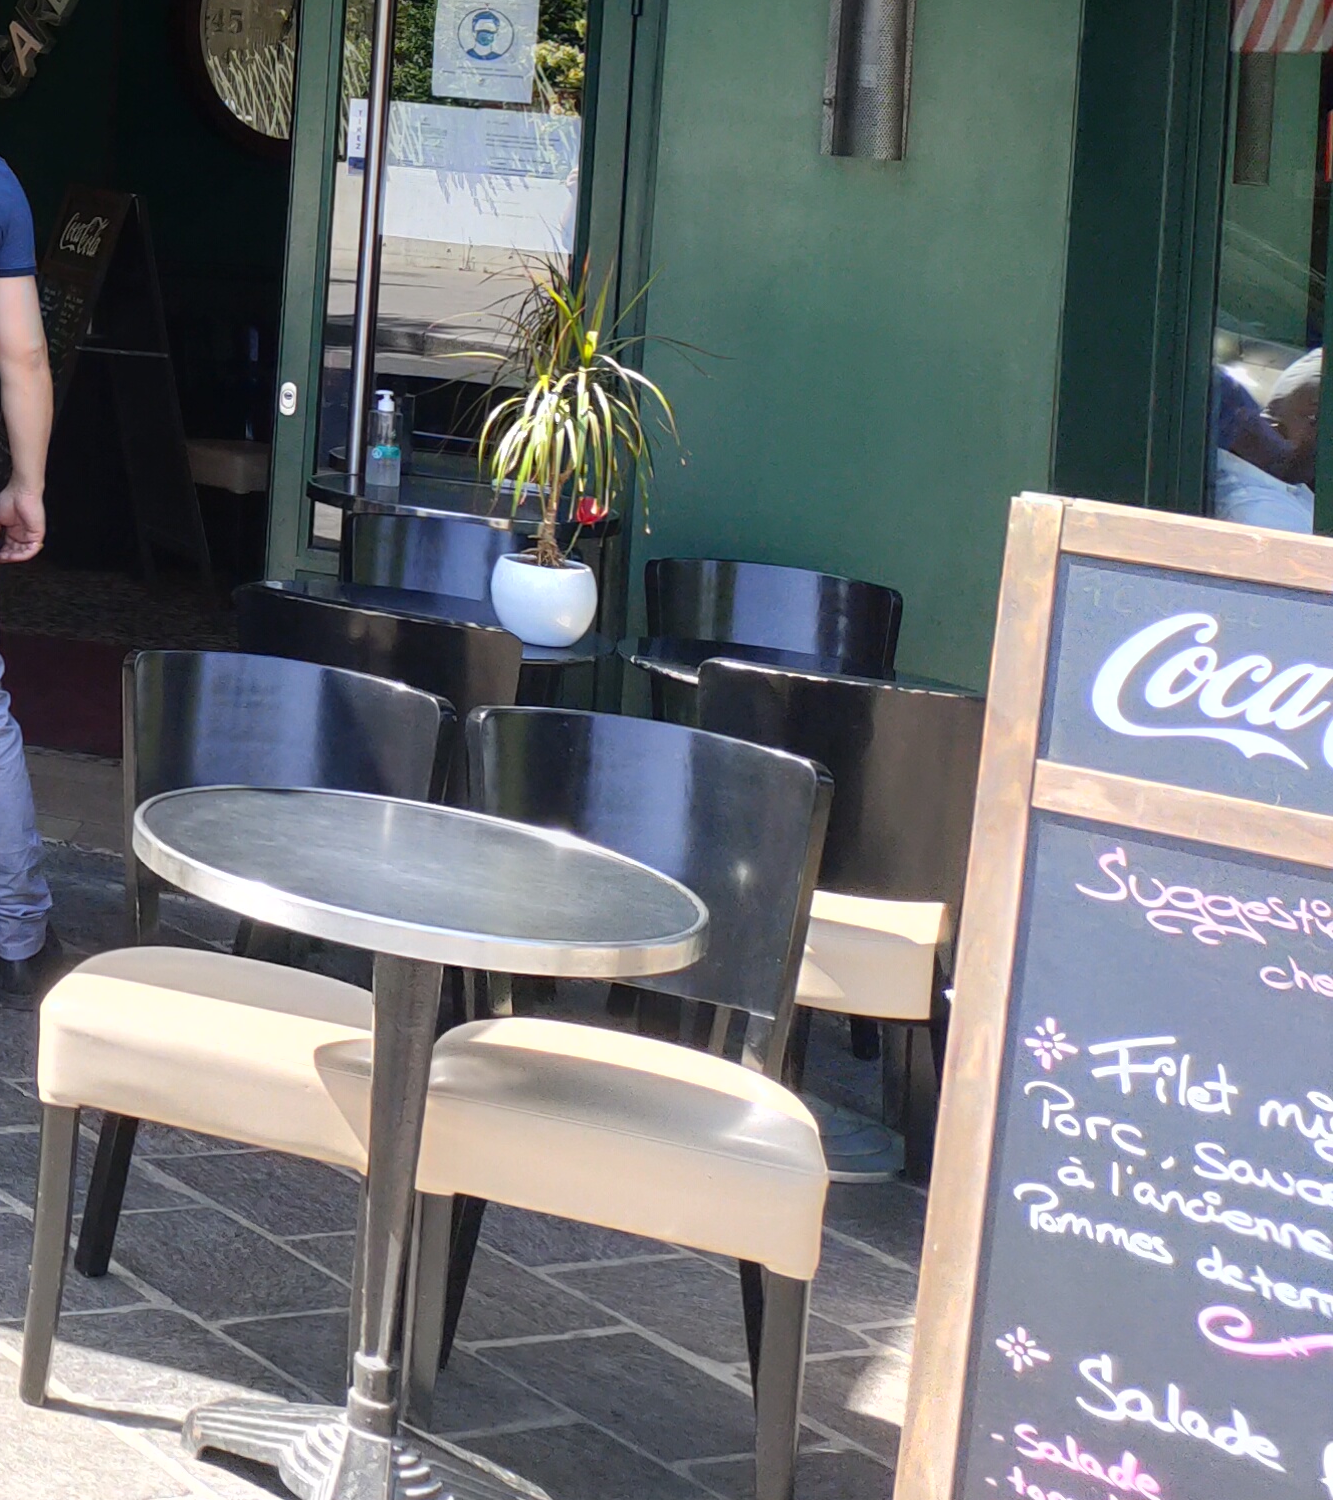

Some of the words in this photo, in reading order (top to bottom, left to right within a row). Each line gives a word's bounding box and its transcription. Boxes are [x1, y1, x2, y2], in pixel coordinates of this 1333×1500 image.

[355, 108, 364, 150] TIREZ
[1087, 1035, 1240, 1116] Filet
[1057, 1156, 1096, 1190] à
[1013, 1182, 1174, 1266] Pommes
[1076, 1352, 1289, 1474] Salade
[1013, 1422, 1163, 1500] Salade
